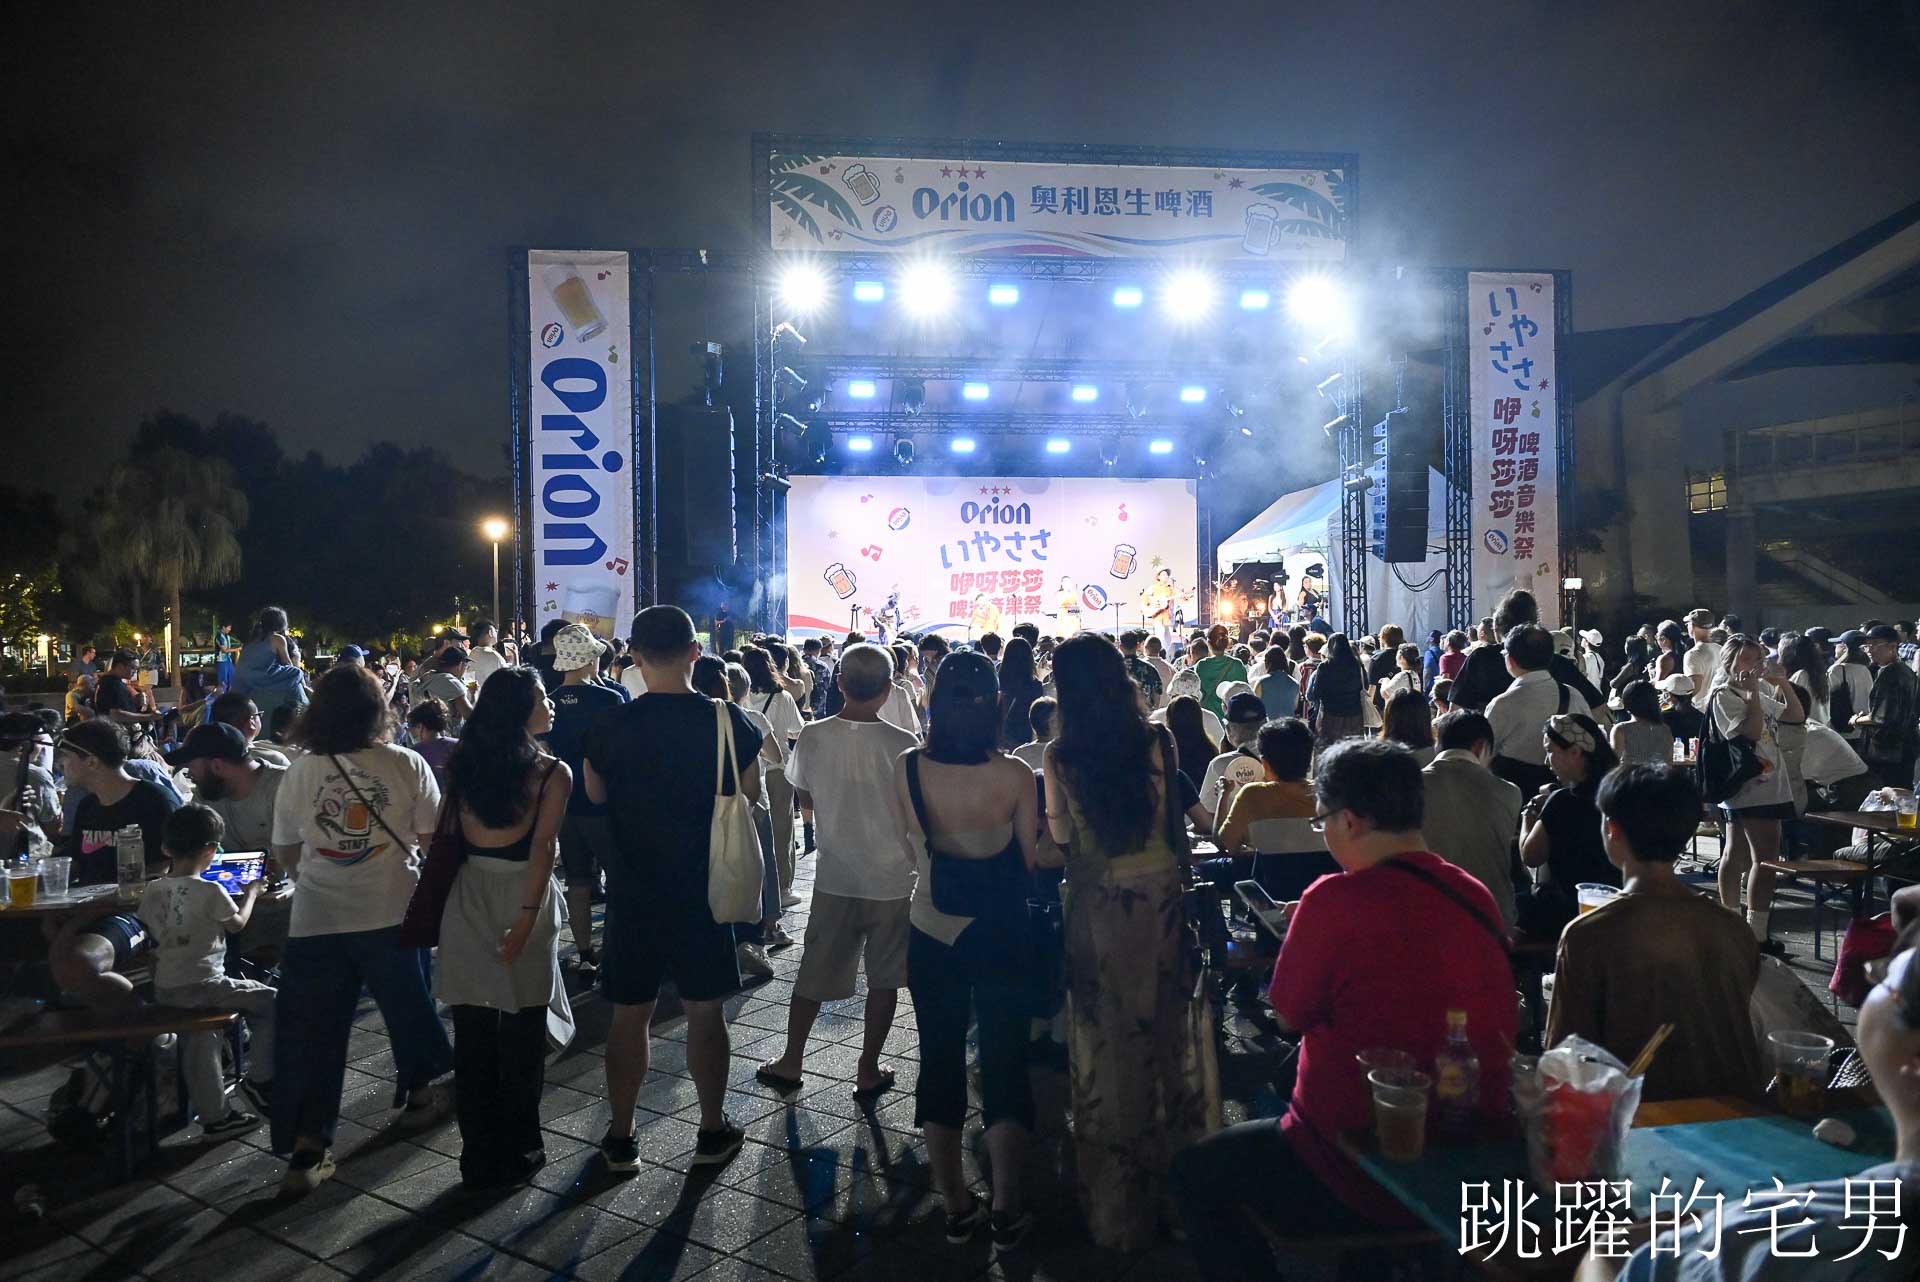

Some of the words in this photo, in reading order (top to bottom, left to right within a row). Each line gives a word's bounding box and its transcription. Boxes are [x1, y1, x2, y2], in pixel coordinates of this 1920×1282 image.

[912, 181, 1015, 223] Orion
[540, 357, 624, 566] Orion
[1489, 397, 1521, 519] 咿呀莎莎
[960, 496, 1031, 524] Orion
[1514, 431, 1541, 560] 啤酒音樂祭
[940, 528, 1051, 569] いやささ
[950, 569, 1044, 595] 咿呀莎莎
[338, 838, 370, 851] STAFF
